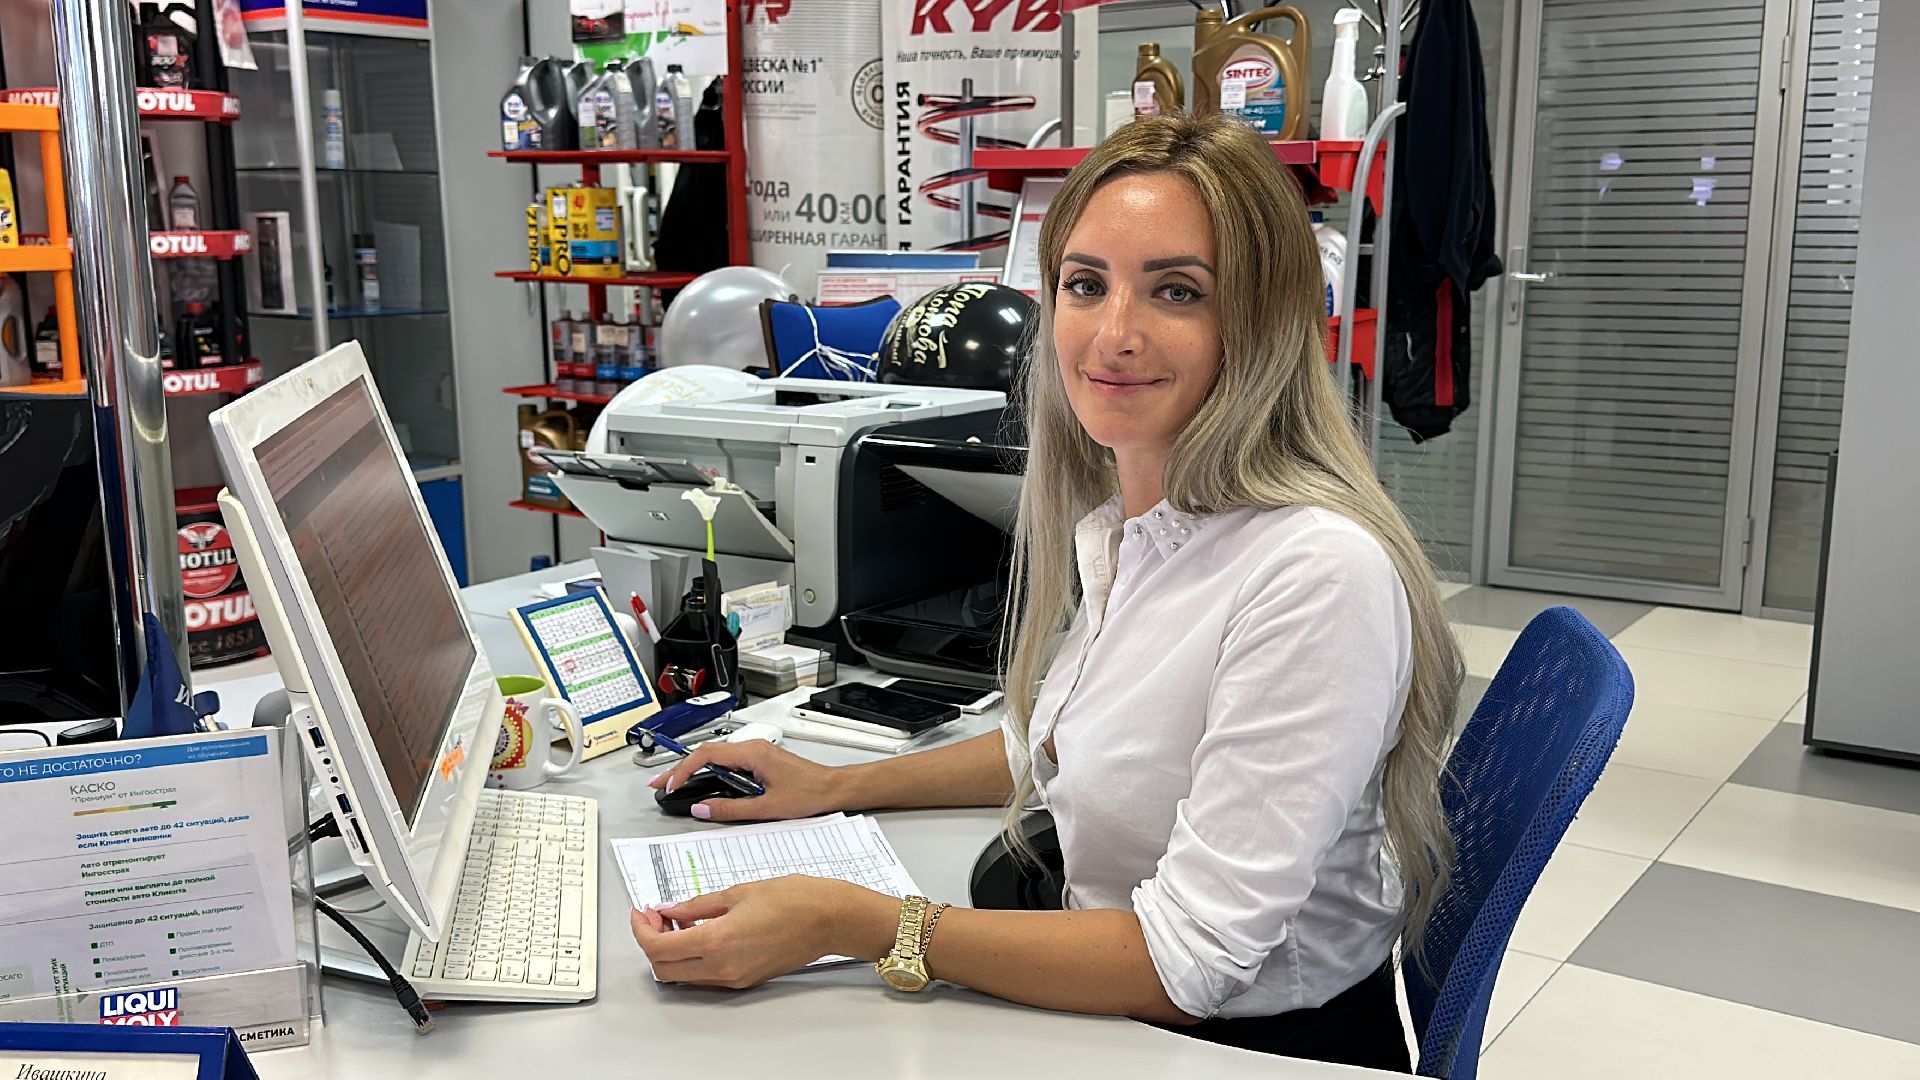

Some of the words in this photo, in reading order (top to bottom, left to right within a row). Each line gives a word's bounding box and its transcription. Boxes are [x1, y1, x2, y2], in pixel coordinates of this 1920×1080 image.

[911, 0, 1062, 35] KYB
[1226, 67, 1271, 79] SINTEC
[897, 81, 911, 225] ГАРАНТИЯ
[20, 764, 38, 776] НЕ
[42, 754, 142, 776] ДОСТАТОЧНО?
[70, 781, 116, 796] КАСКО
[76, 831, 108, 841] Защита
[109, 828, 139, 837] своего
[99, 838, 130, 847] Клиент
[132, 833, 172, 843] виновник
[103, 853, 166, 868] отремонтирует
[81, 867, 130, 878] Ингосстрах
[84, 888, 115, 897] Ремонт
[135, 881, 170, 891] выплаты
[185, 874, 215, 884] полной
[85, 895, 130, 905] стоимости
[152, 887, 187, 898] Клиента
[89, 919, 133, 930] Защищено
[134, 917, 146, 925] до
[147, 914, 158, 922] 42
[160, 909, 200, 921] ситуаций,
[103, 989, 175, 1017] LIQUI
[239, 1027, 295, 1042] СМЕТИКА
